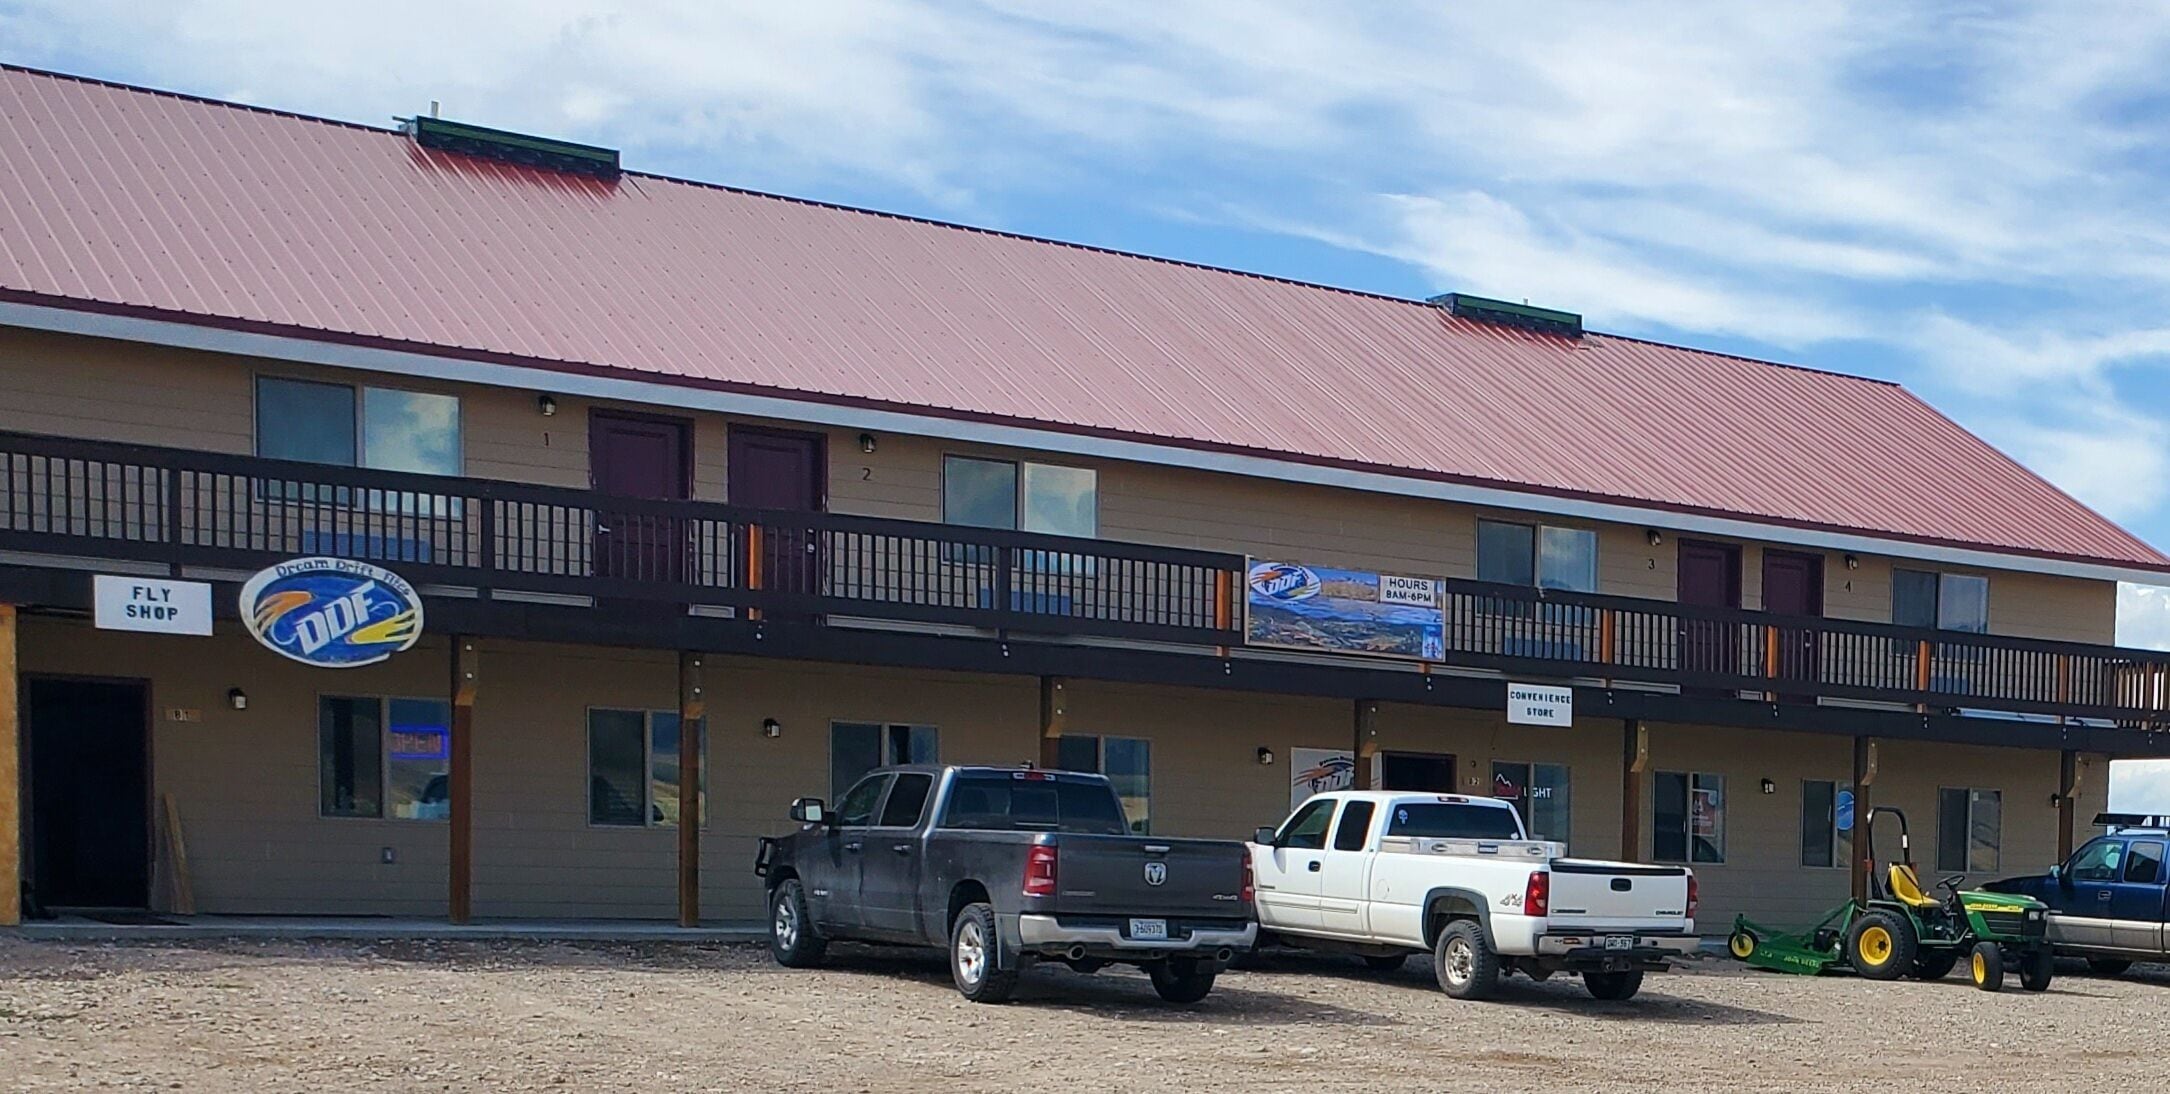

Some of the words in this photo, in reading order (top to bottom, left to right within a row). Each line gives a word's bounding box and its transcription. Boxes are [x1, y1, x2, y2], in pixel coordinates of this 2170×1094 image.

[543, 432, 549, 447] 1
[862, 467, 873, 481] 2
[275, 559, 330, 577] Dream
[335, 560, 374, 577] Drift
[1648, 558, 1656, 571] 3
[1389, 577, 1429, 591] HOURS
[1844, 580, 1852, 593] 4
[132, 586, 171, 603] FLY
[1386, 589, 1432, 603] 8AM-6PM
[126, 604, 178, 621] SHOP
[293, 580, 377, 656] DDF
[1510, 691, 1571, 704] CONVENIENCE
[1526, 707, 1555, 718] STORE
[1522, 786, 1552, 799] LGHT
